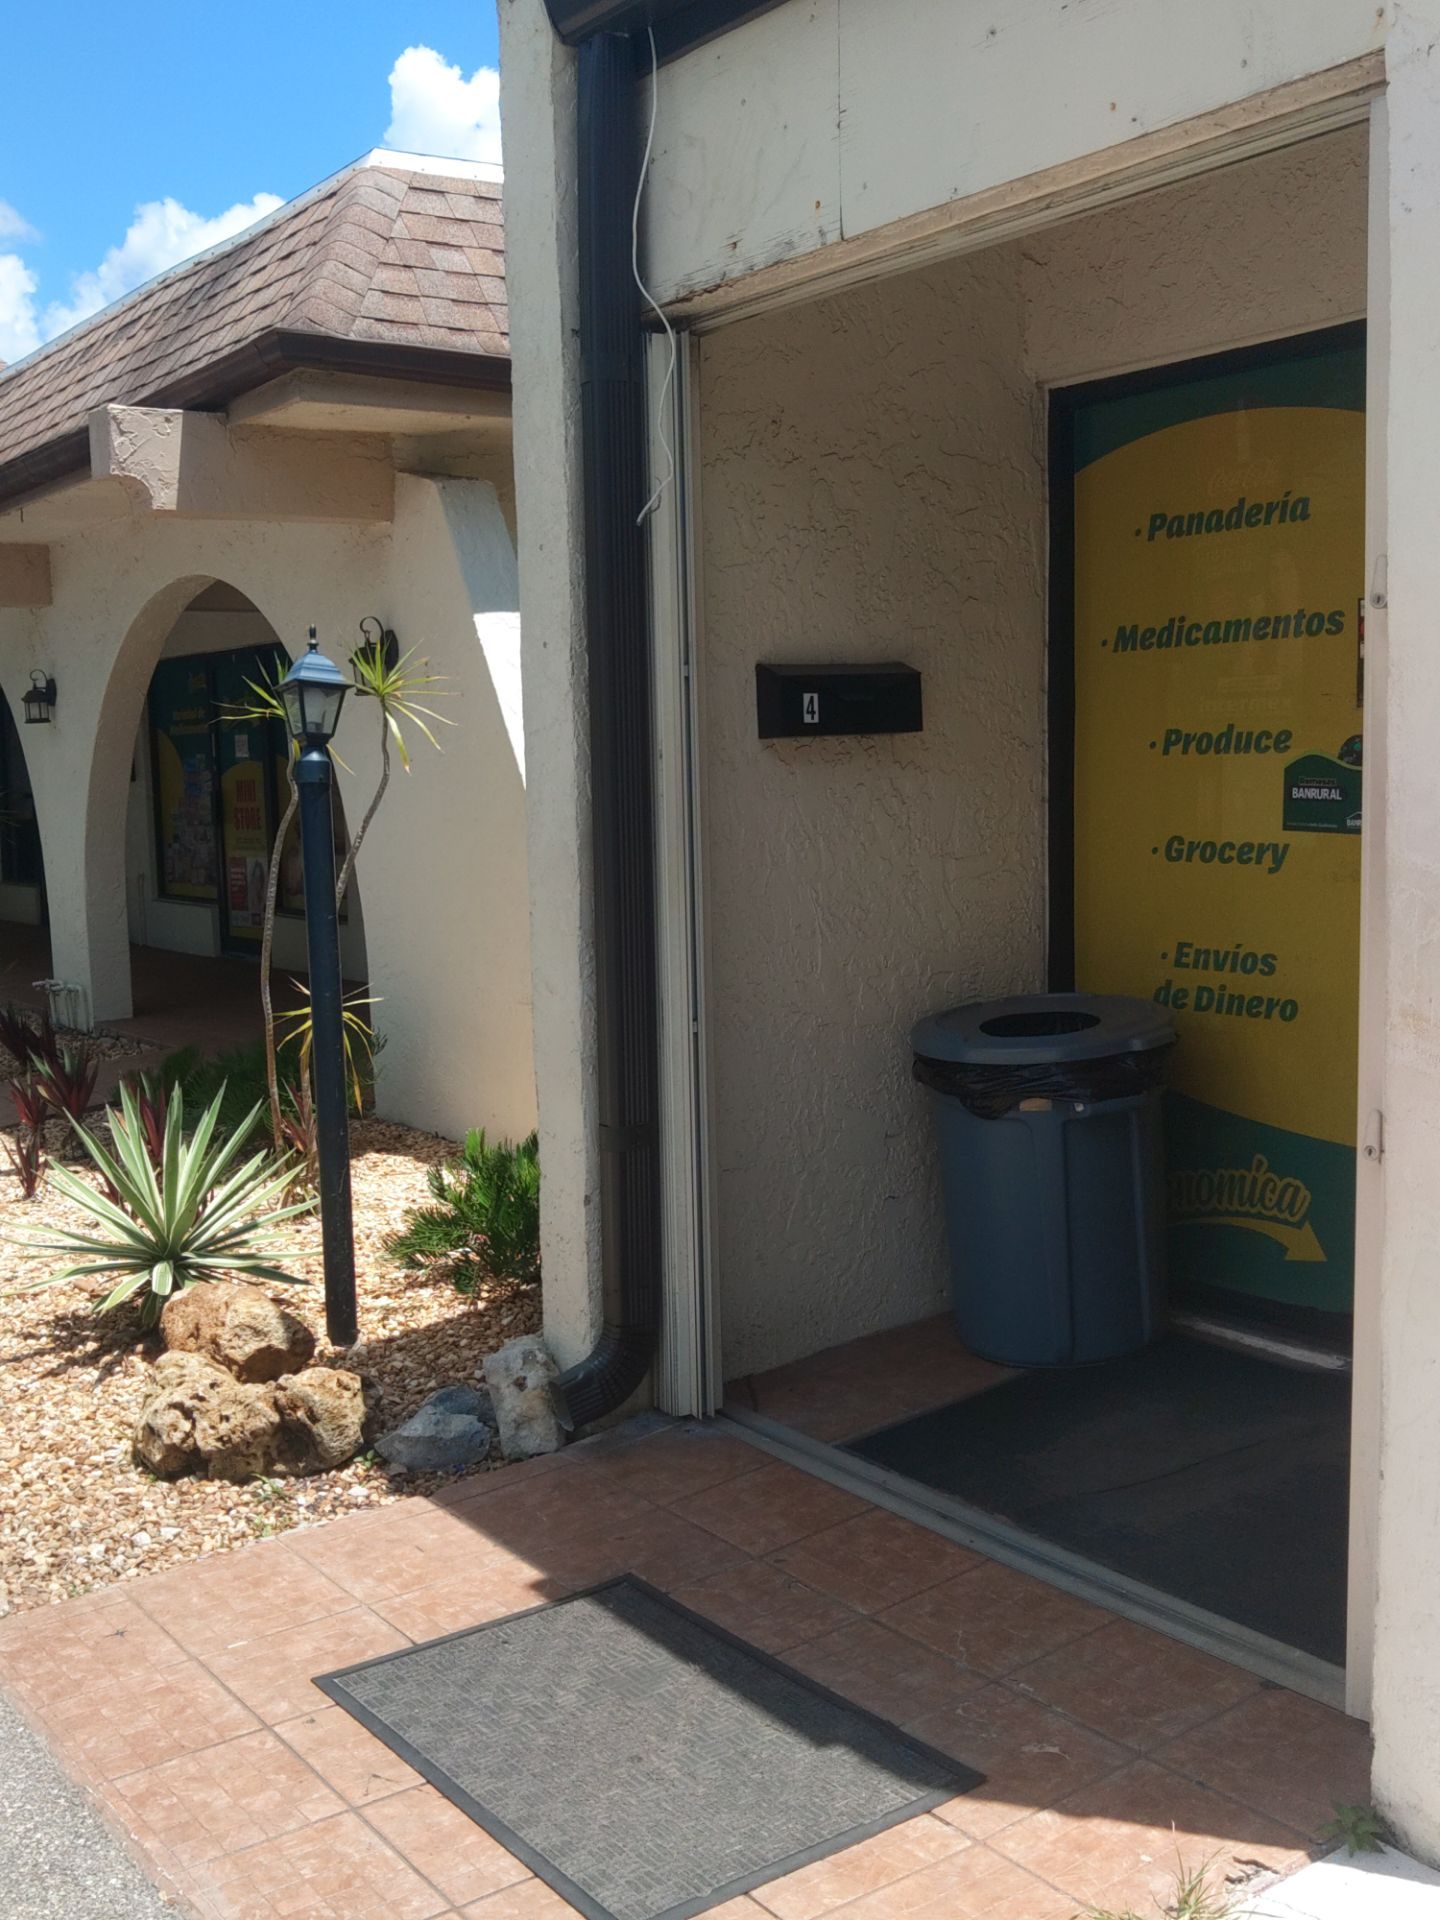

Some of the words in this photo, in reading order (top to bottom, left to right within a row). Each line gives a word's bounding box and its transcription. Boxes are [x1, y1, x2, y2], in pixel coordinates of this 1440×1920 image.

[1147, 490, 1311, 542] Panadería
[1112, 608, 1346, 653] Medicamentos
[805, 695, 817, 721] 4
[1162, 723, 1293, 756] Produce
[1292, 787, 1342, 801] BANRURAL
[1164, 835, 1290, 874] Grocery
[1173, 942, 1278, 977] Envíos
[1153, 979, 1189, 1009] de
[1194, 983, 1298, 1022] Dinero
